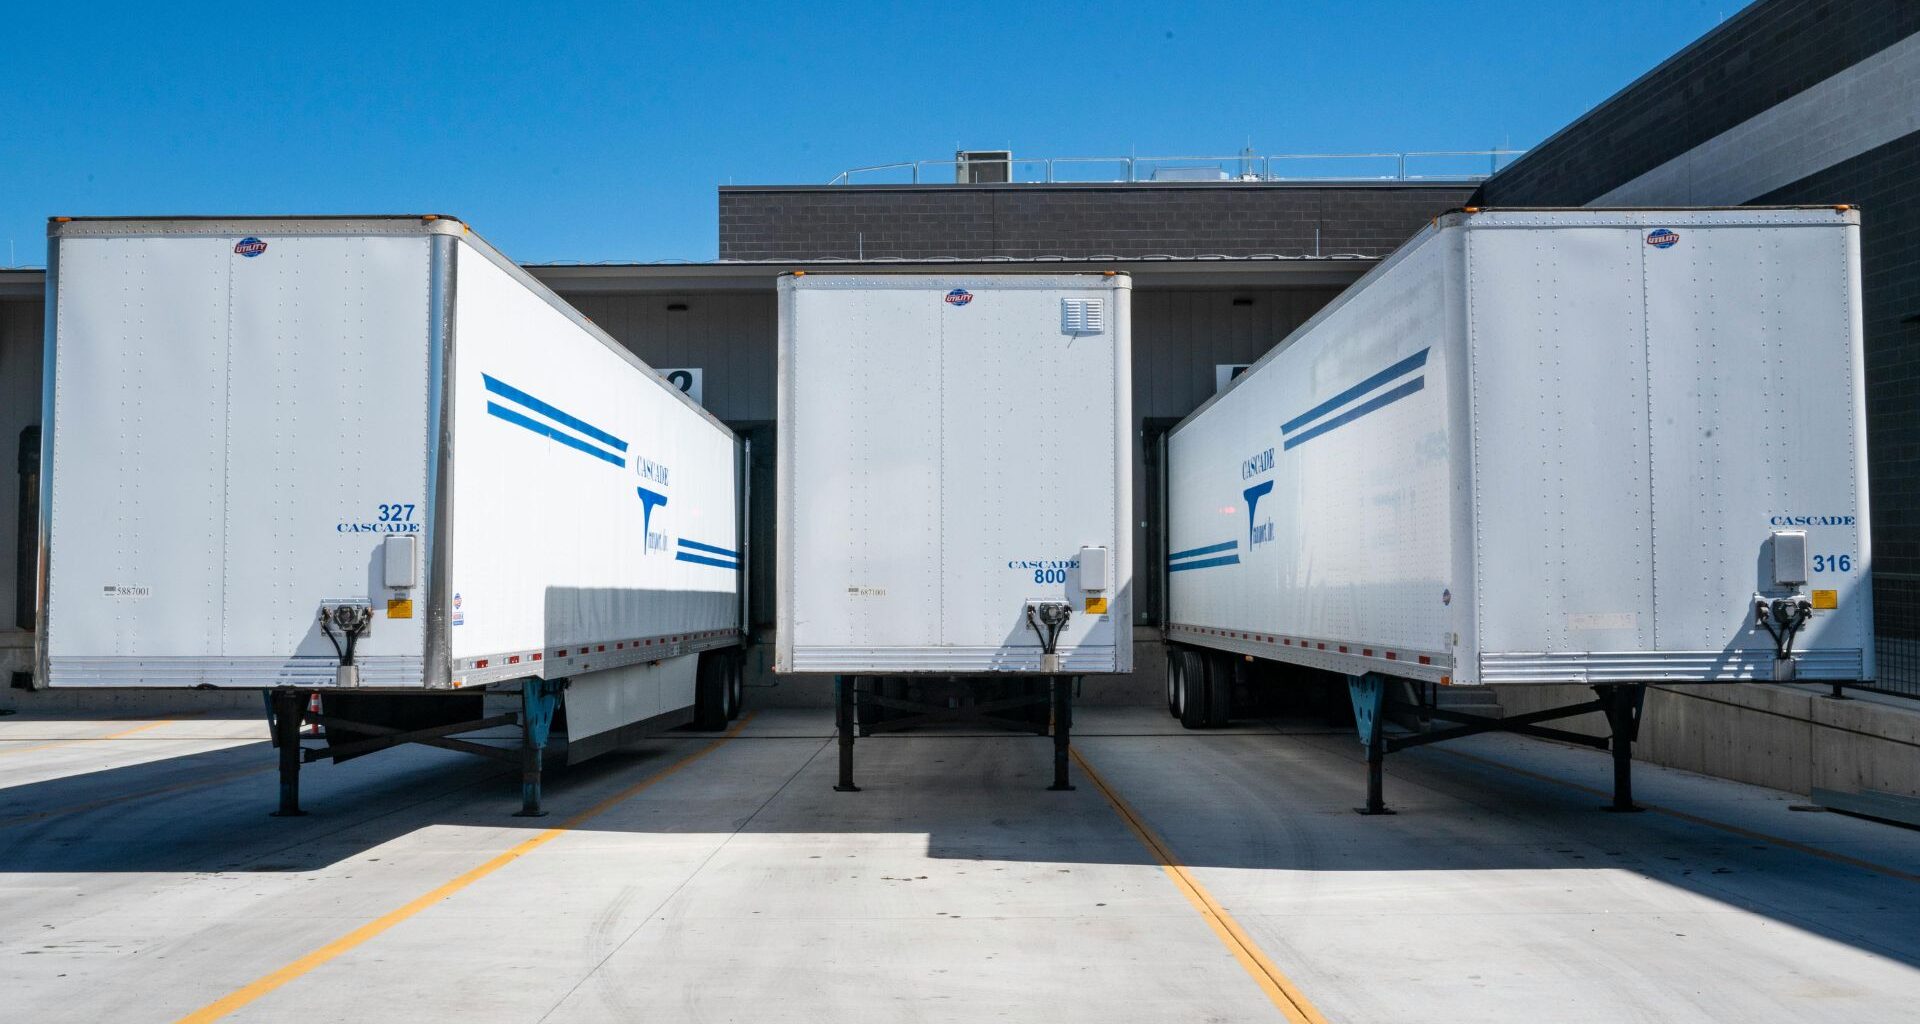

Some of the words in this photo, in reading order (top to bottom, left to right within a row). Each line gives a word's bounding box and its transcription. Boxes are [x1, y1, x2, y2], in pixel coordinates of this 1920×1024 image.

[1648, 234, 1679, 244] UTILITY
[235, 243, 266, 253] UTILITY
[946, 294, 972, 302] UTILITY
[1242, 448, 1274, 480] CASCADE
[637, 455, 669, 486] CASCADE
[378, 504, 415, 521] 327
[1770, 516, 1855, 525] CASCADE
[337, 523, 420, 532] CASCADE
[1813, 554, 1850, 572] 316
[1034, 569, 1066, 584] 800
